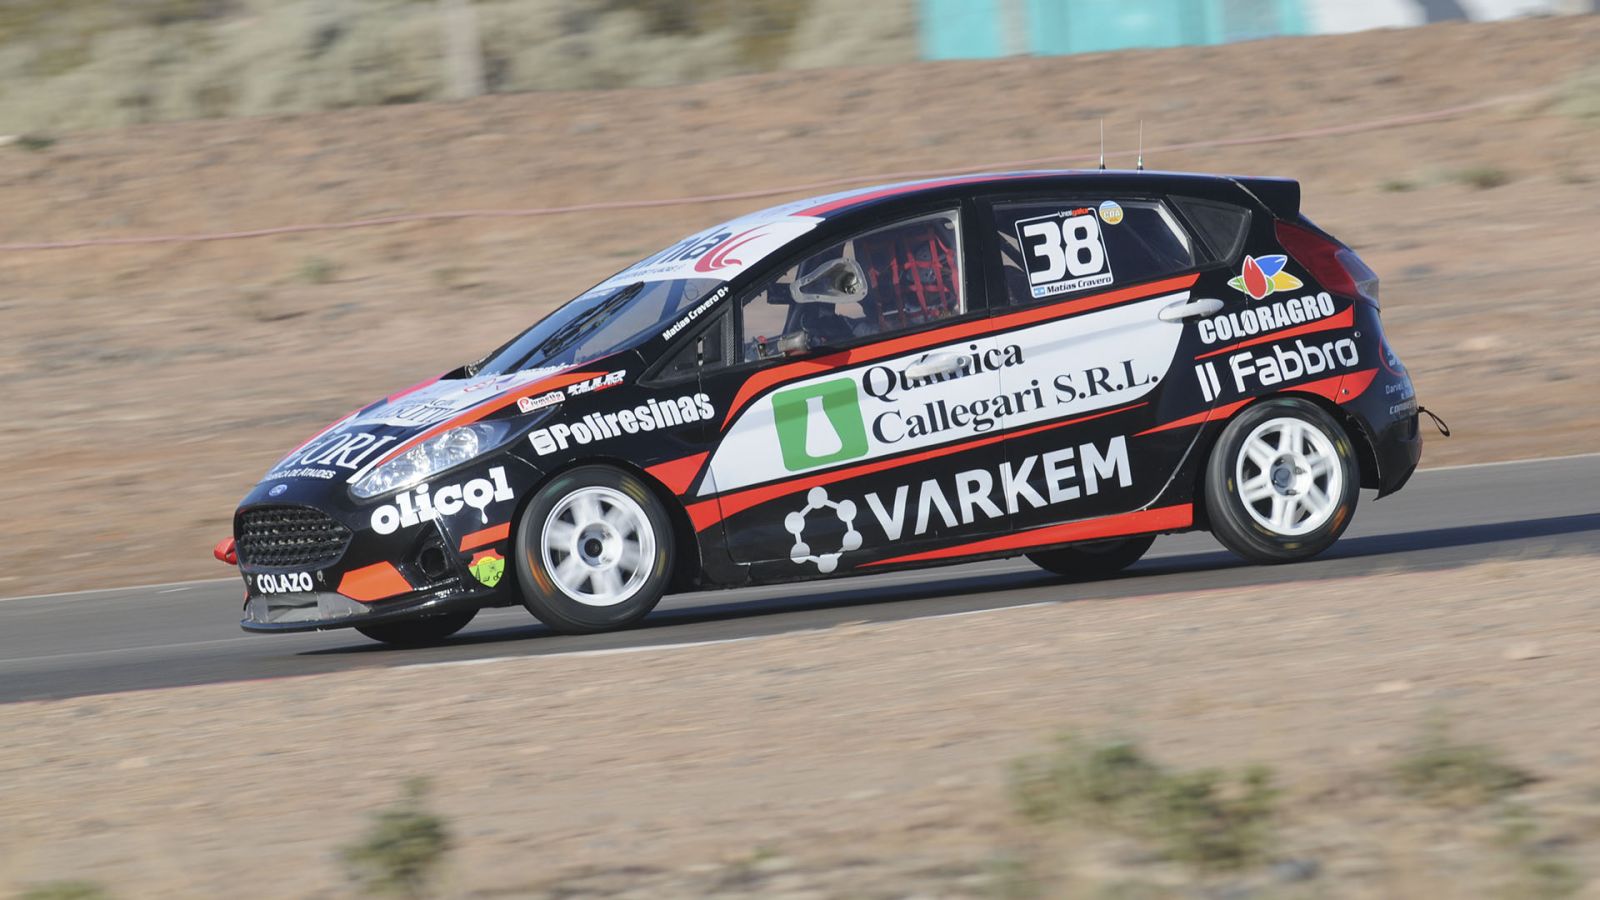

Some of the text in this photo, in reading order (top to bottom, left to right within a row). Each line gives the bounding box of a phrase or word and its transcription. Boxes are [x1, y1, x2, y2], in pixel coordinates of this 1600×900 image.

[1023, 214, 1104, 284] 38
[688, 294, 719, 320] Cravero
[1077, 276, 1111, 288] Cravero
[1198, 292, 1335, 344] COLORAGRO
[1229, 338, 1359, 393] Fabbro
[549, 392, 715, 450] Poliresinas
[872, 359, 1159, 444] Callegari S.R.L.
[370, 465, 514, 535] olicol
[864, 435, 1133, 541] VARKEM
[256, 571, 313, 593] COLAZO
